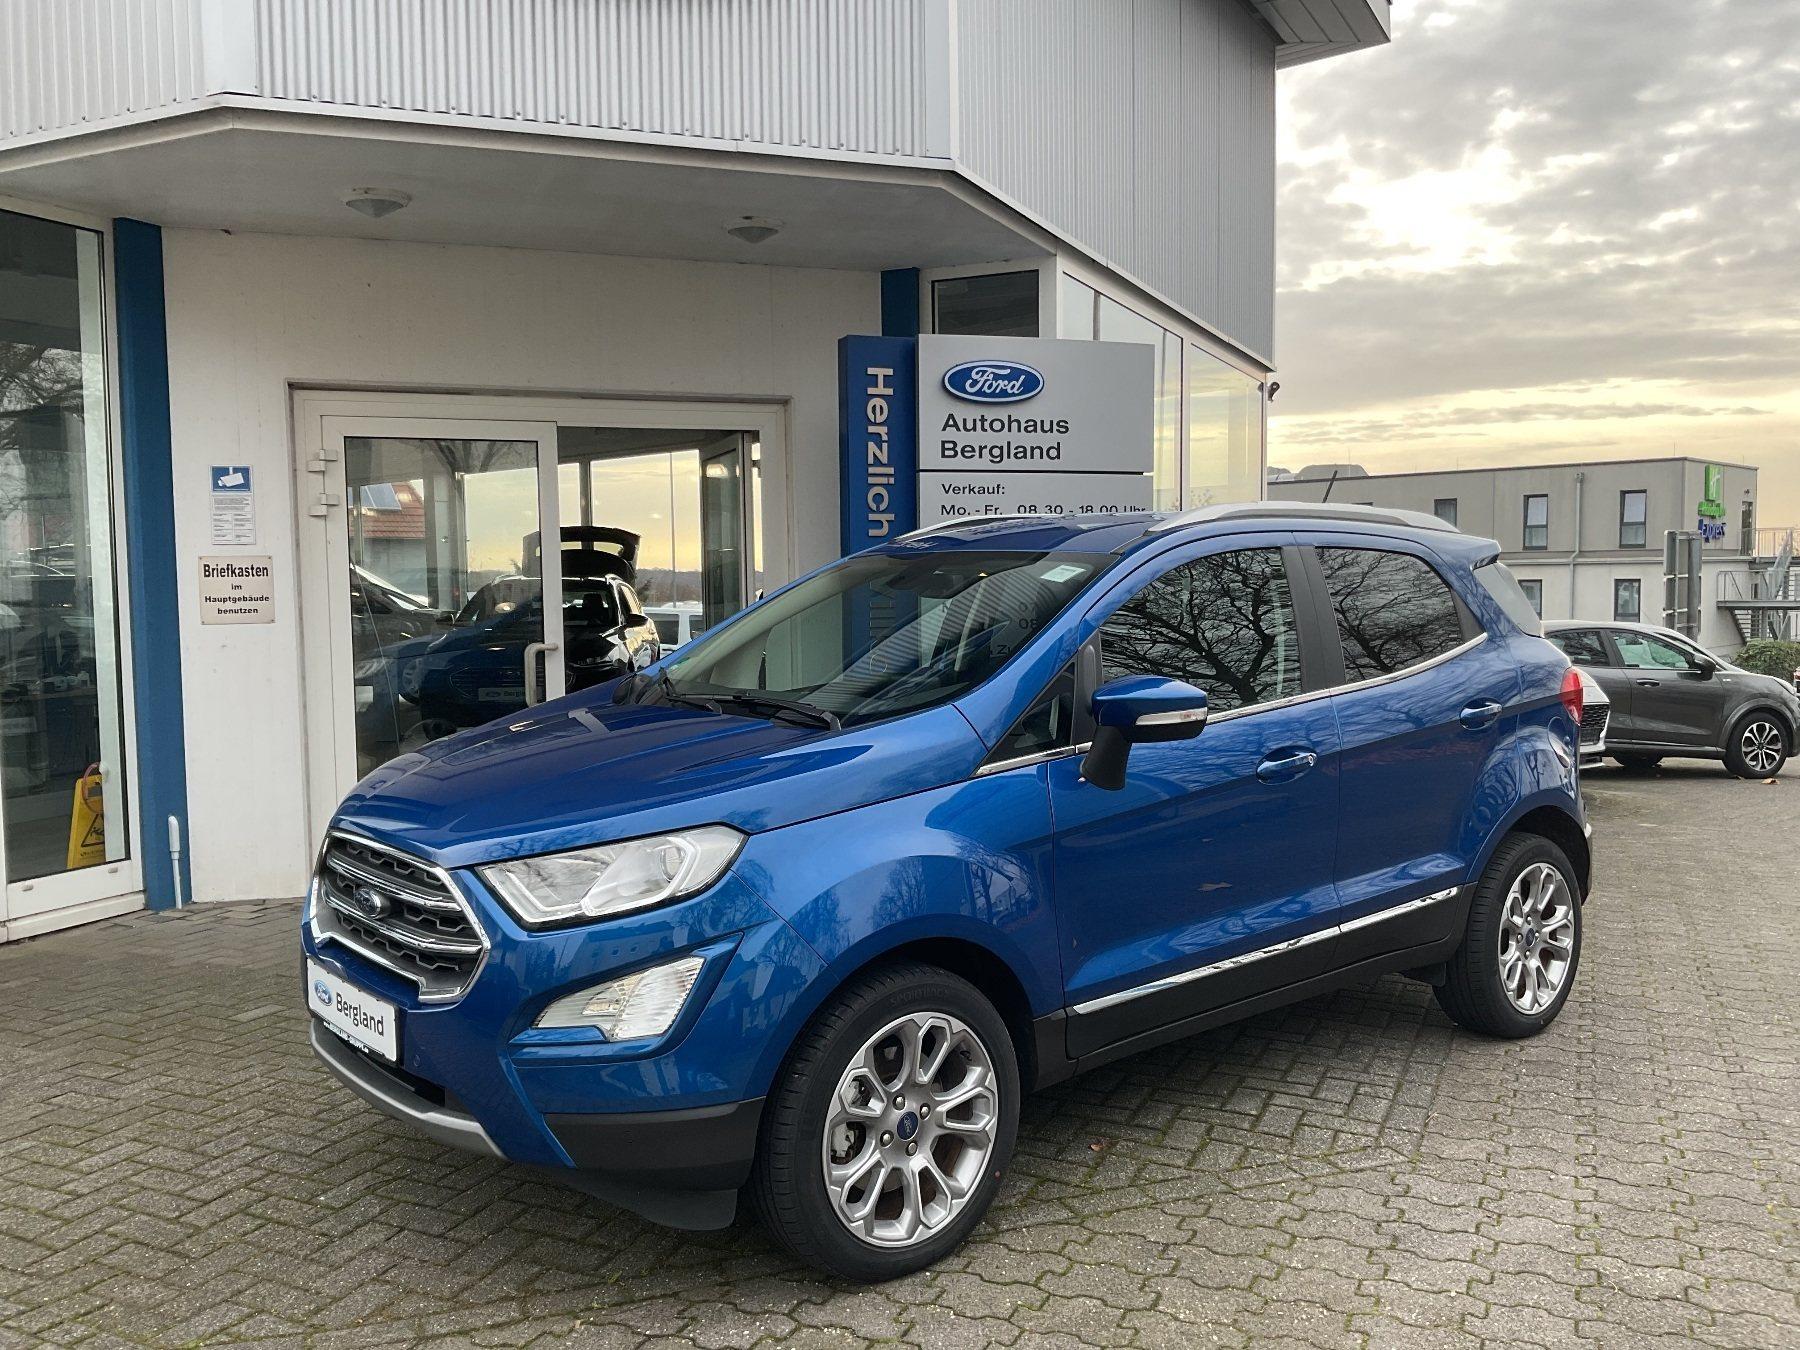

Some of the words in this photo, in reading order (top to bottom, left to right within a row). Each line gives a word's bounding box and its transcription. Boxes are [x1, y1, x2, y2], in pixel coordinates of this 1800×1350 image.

[941, 412, 1070, 435] Autohaus
[866, 367, 895, 537] Herzlich
[940, 439, 1062, 464] Bergland
[941, 483, 1006, 496] Verkauf:
[940, 504, 971, 516] Mo.
[984, 504, 1003, 516] Fr.
[1017, 504, 1064, 515] 0830
[1079, 504, 1119, 515] 1800
[203, 564, 269, 578] Briefkasten
[204, 595, 270, 604] Hauptgebäude
[217, 607, 258, 615] benutzen
[336, 991, 385, 1036] Bergland
